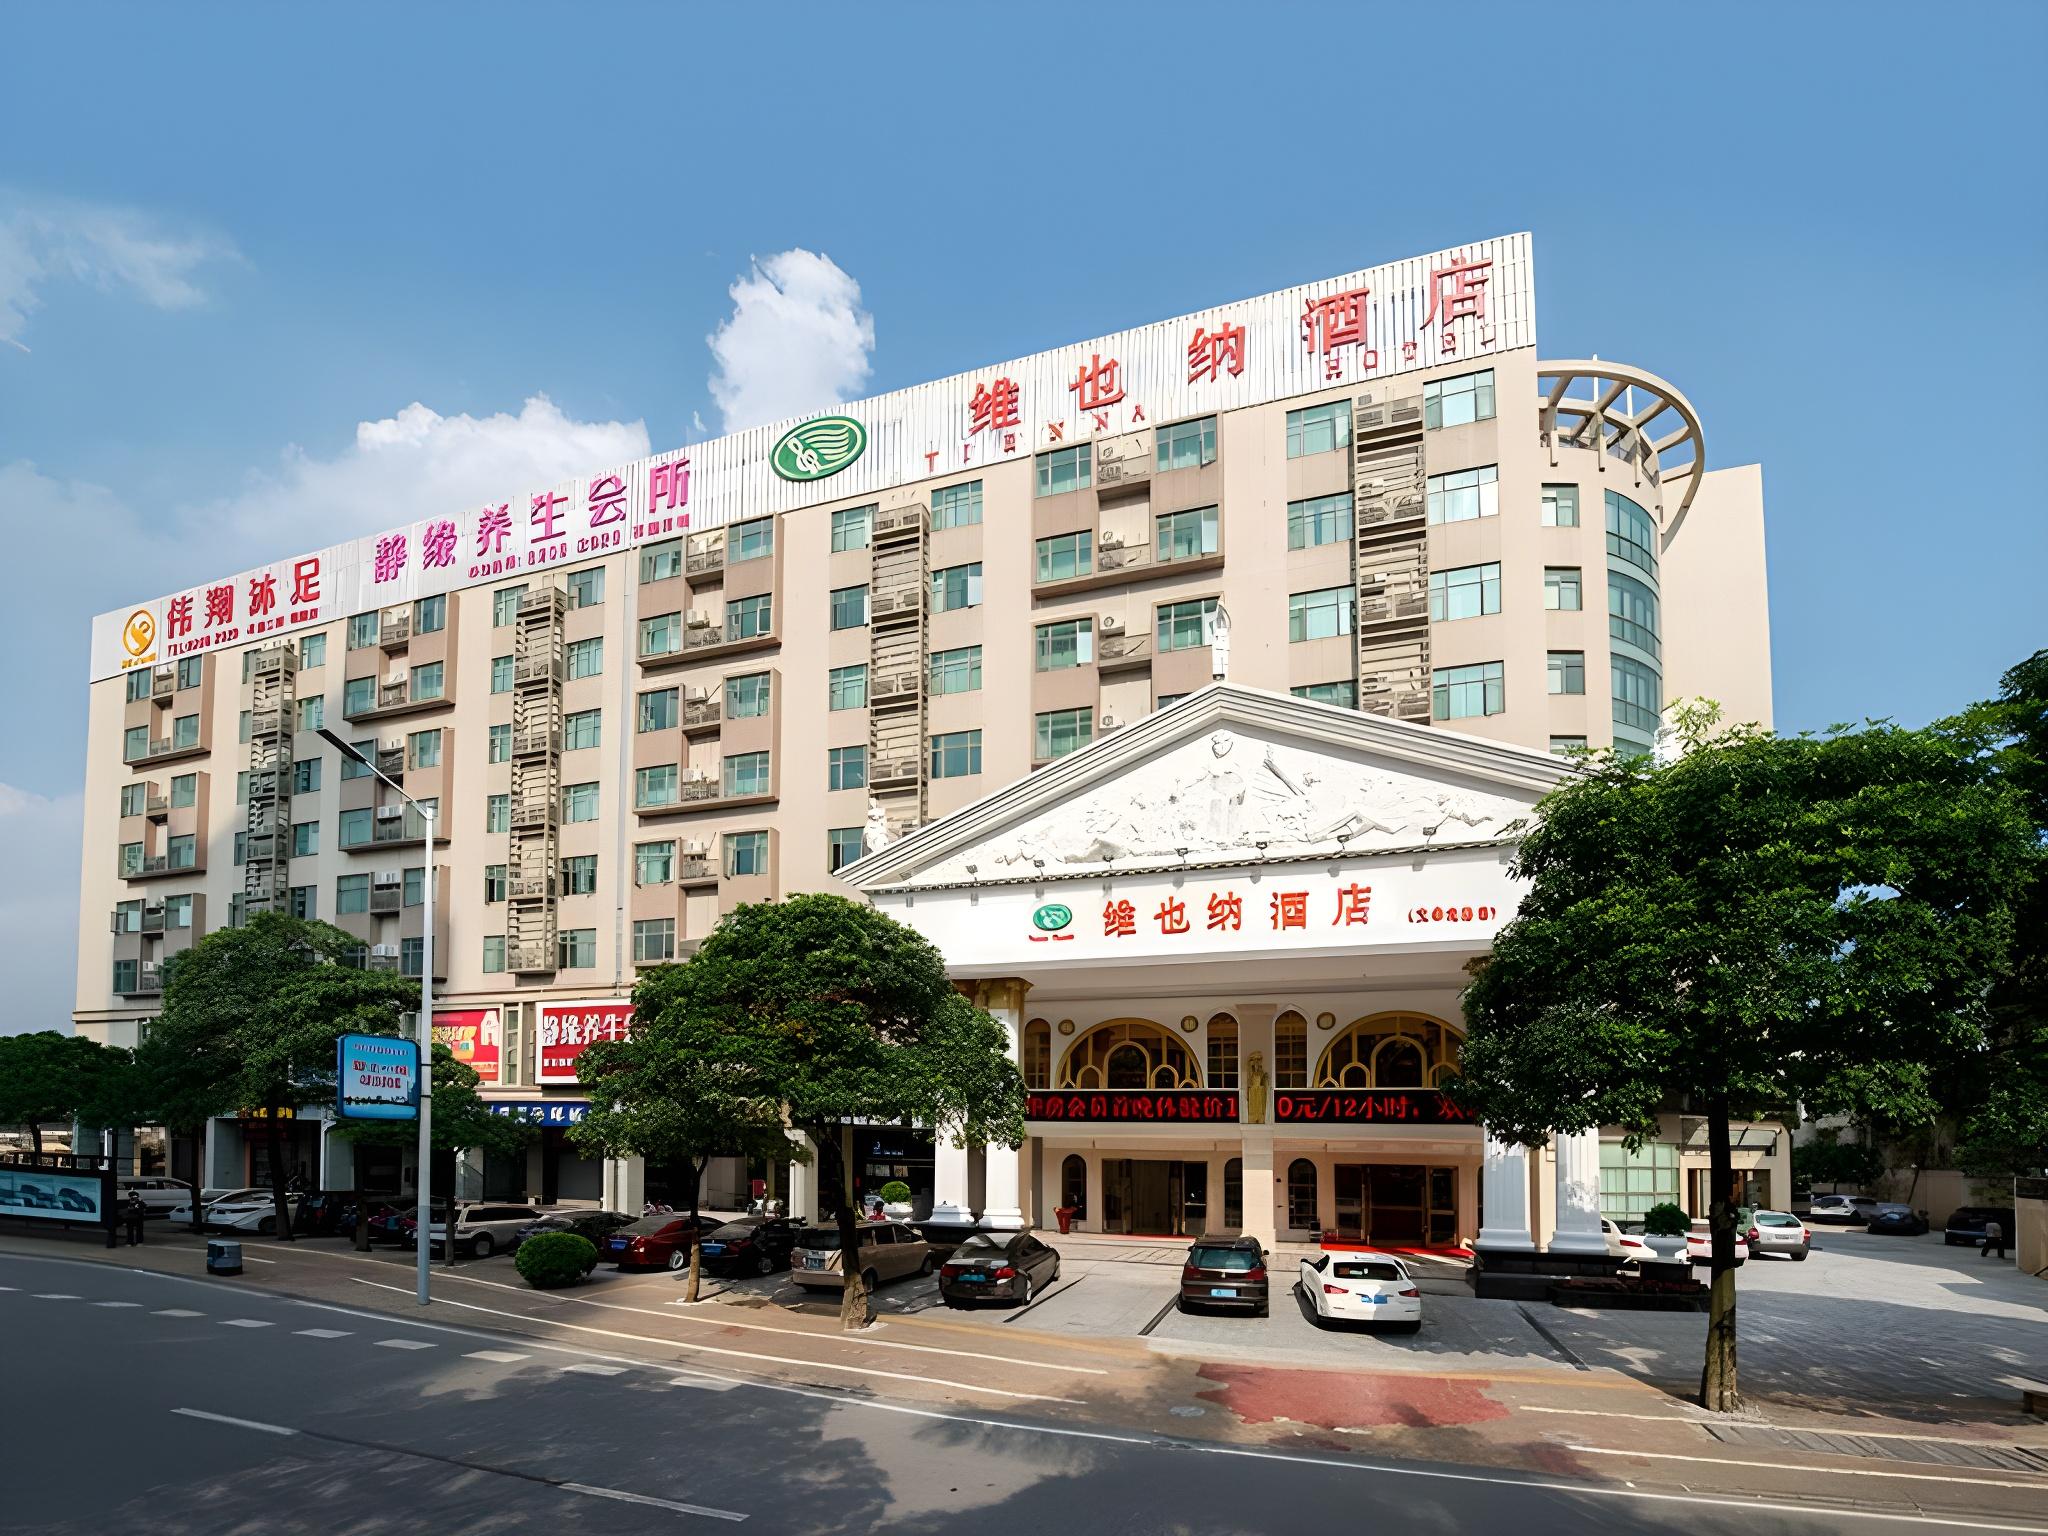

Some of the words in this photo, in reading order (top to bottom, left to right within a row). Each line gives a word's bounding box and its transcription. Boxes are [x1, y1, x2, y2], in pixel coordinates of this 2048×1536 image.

[968, 256, 1492, 437] 维也纳酒店
[1102, 882, 1371, 937] 维也纳酒店
